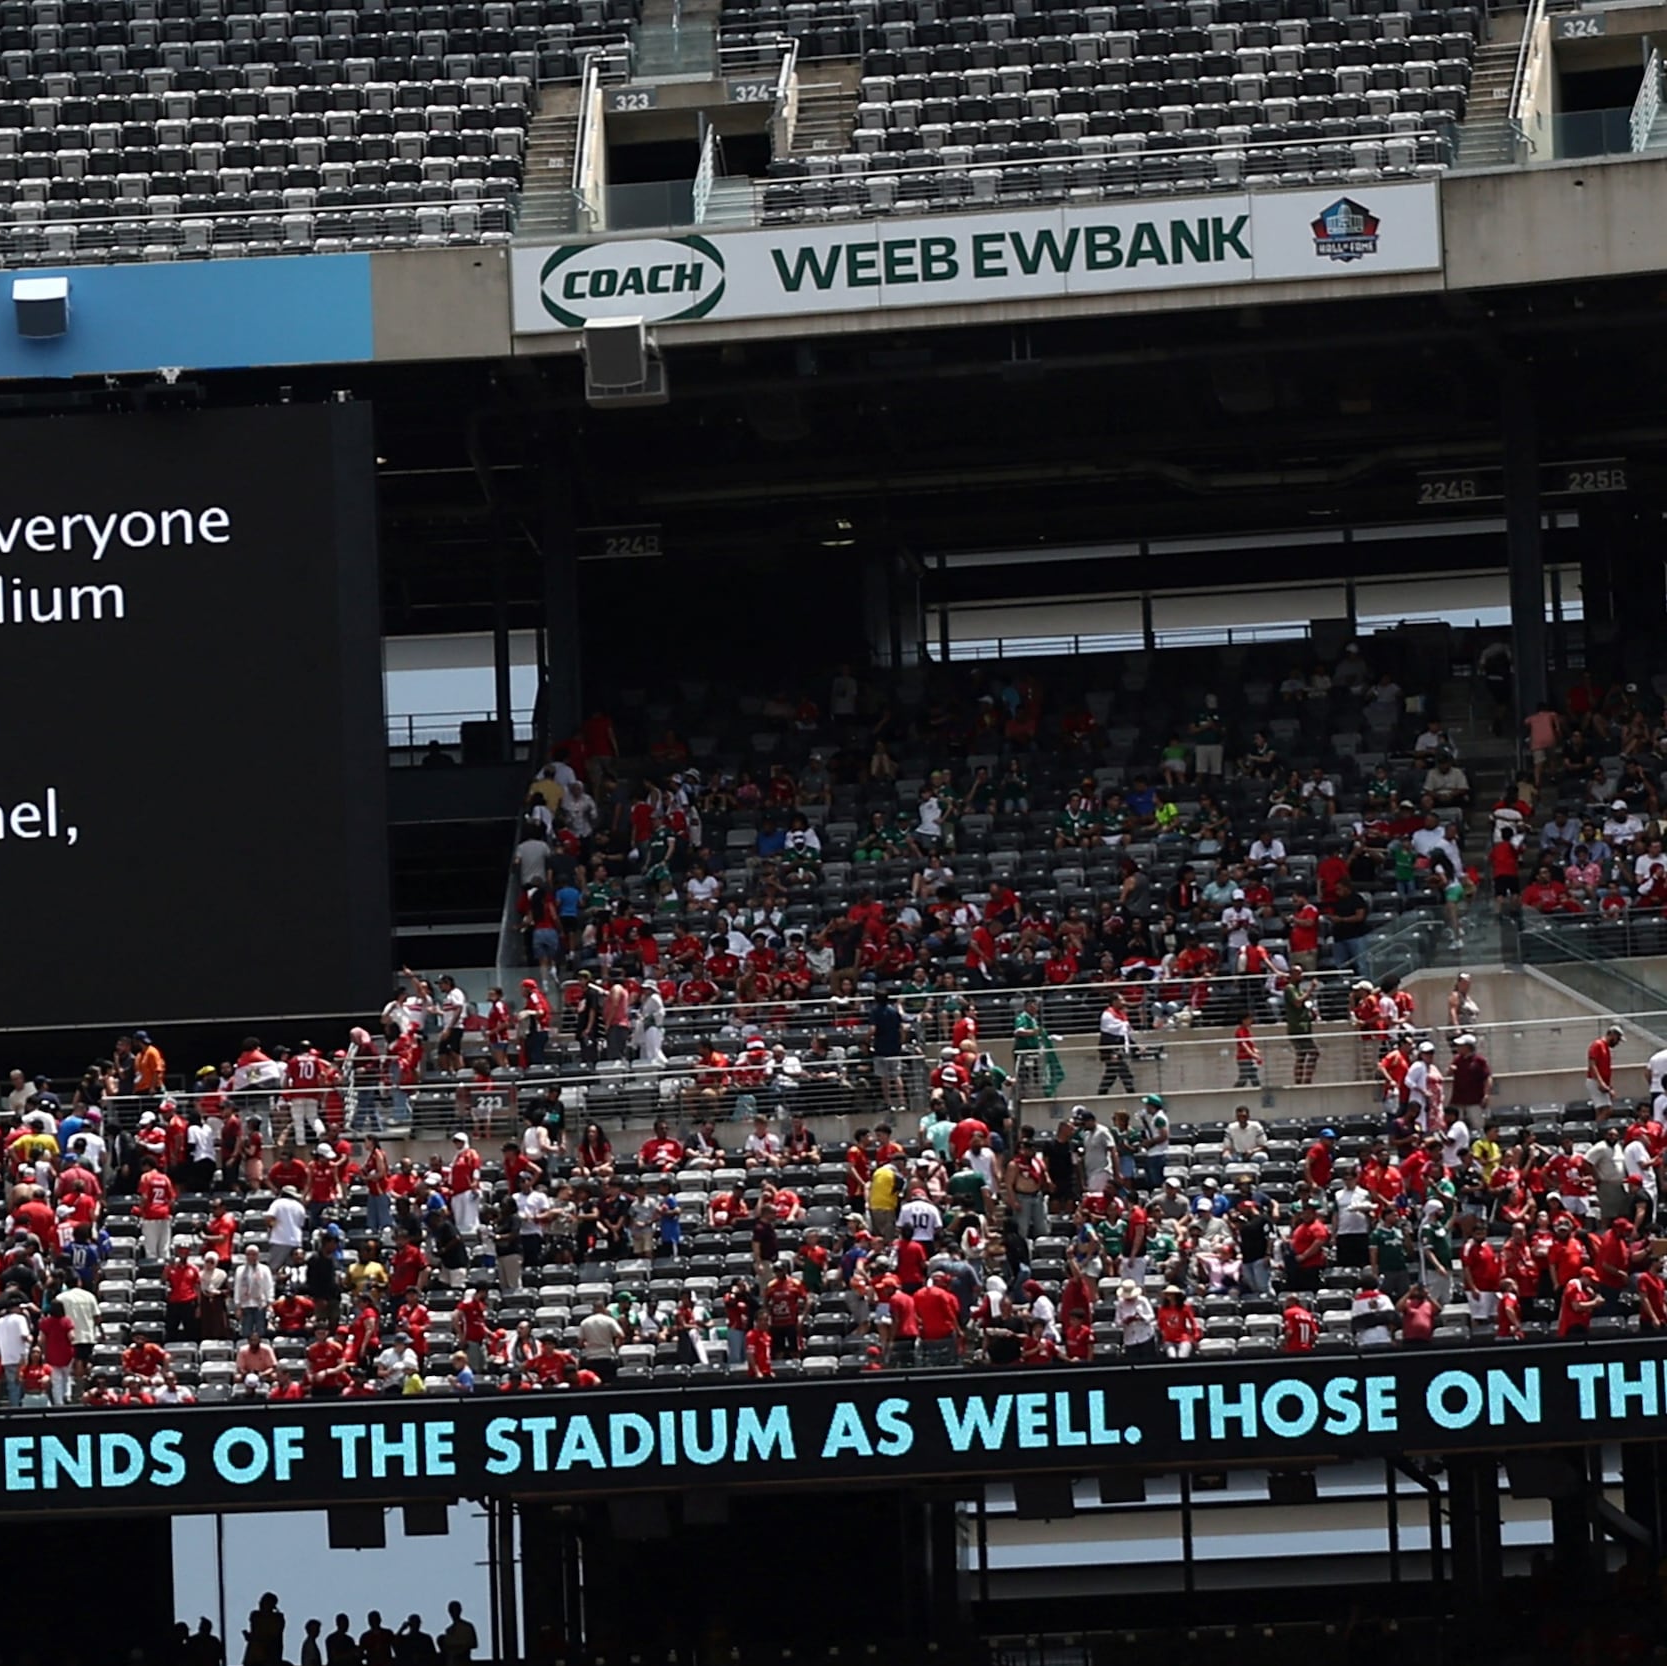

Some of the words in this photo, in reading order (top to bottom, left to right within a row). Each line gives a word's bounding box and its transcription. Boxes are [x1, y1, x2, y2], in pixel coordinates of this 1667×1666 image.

[1563, 18, 1599, 37] 324
[615, 93, 650, 111] 323
[736, 86, 770, 102] 324
[772, 236, 959, 293] WEEB
[973, 213, 1252, 279] EWBANK
[562, 262, 704, 300] COACH
[298, 1062, 315, 1081] 10
[5, 1430, 185, 1490] ENDS
[213, 1427, 304, 1483] OF
[331, 1421, 455, 1478] THE
[486, 1406, 796, 1474] STADIUM
[822, 1398, 913, 1457] AS
[937, 1390, 1141, 1451] WELL.
[1168, 1376, 1397, 1440] THOSE
[1426, 1368, 1540, 1428] ON
[1567, 1360, 1667, 1419] TH
